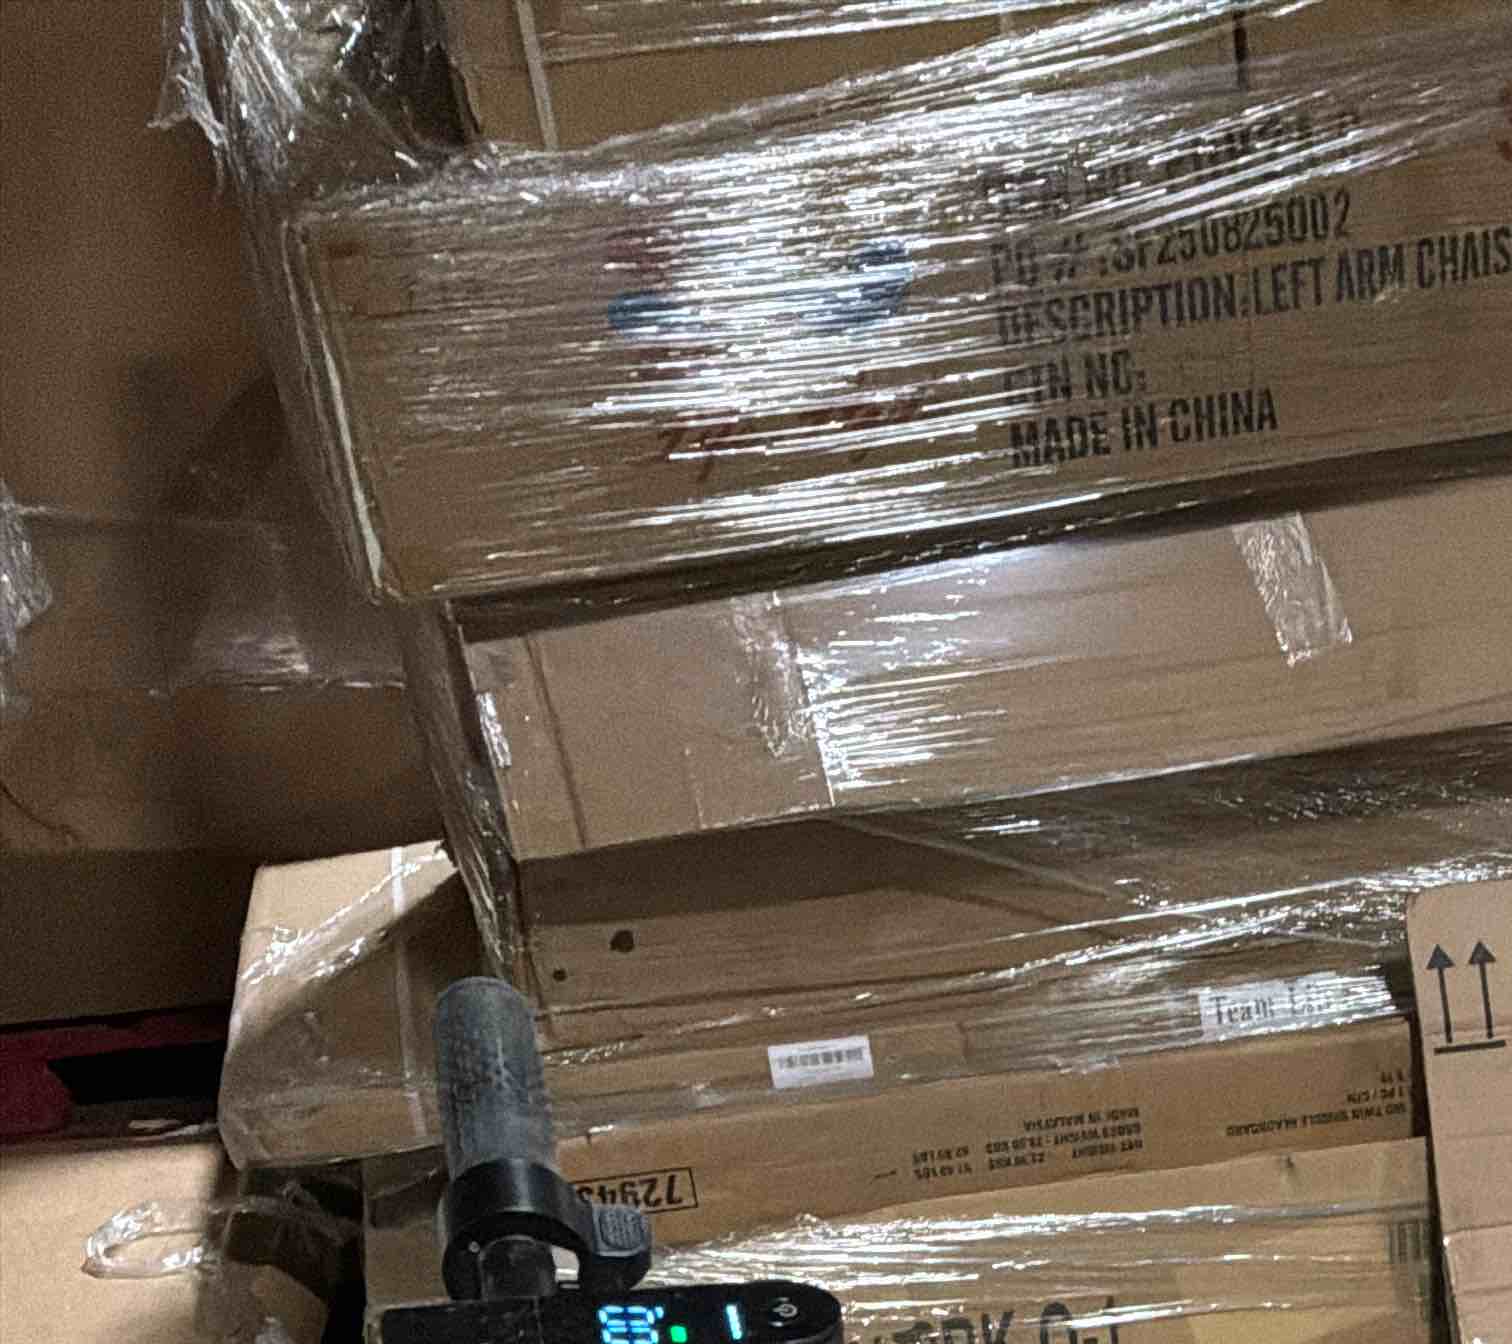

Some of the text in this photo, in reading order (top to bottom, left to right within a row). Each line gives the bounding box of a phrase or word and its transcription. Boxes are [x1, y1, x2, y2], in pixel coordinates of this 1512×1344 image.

[1335, 246, 1405, 304] ARM
[1009, 387, 1279, 468] MADE IN CHINA
